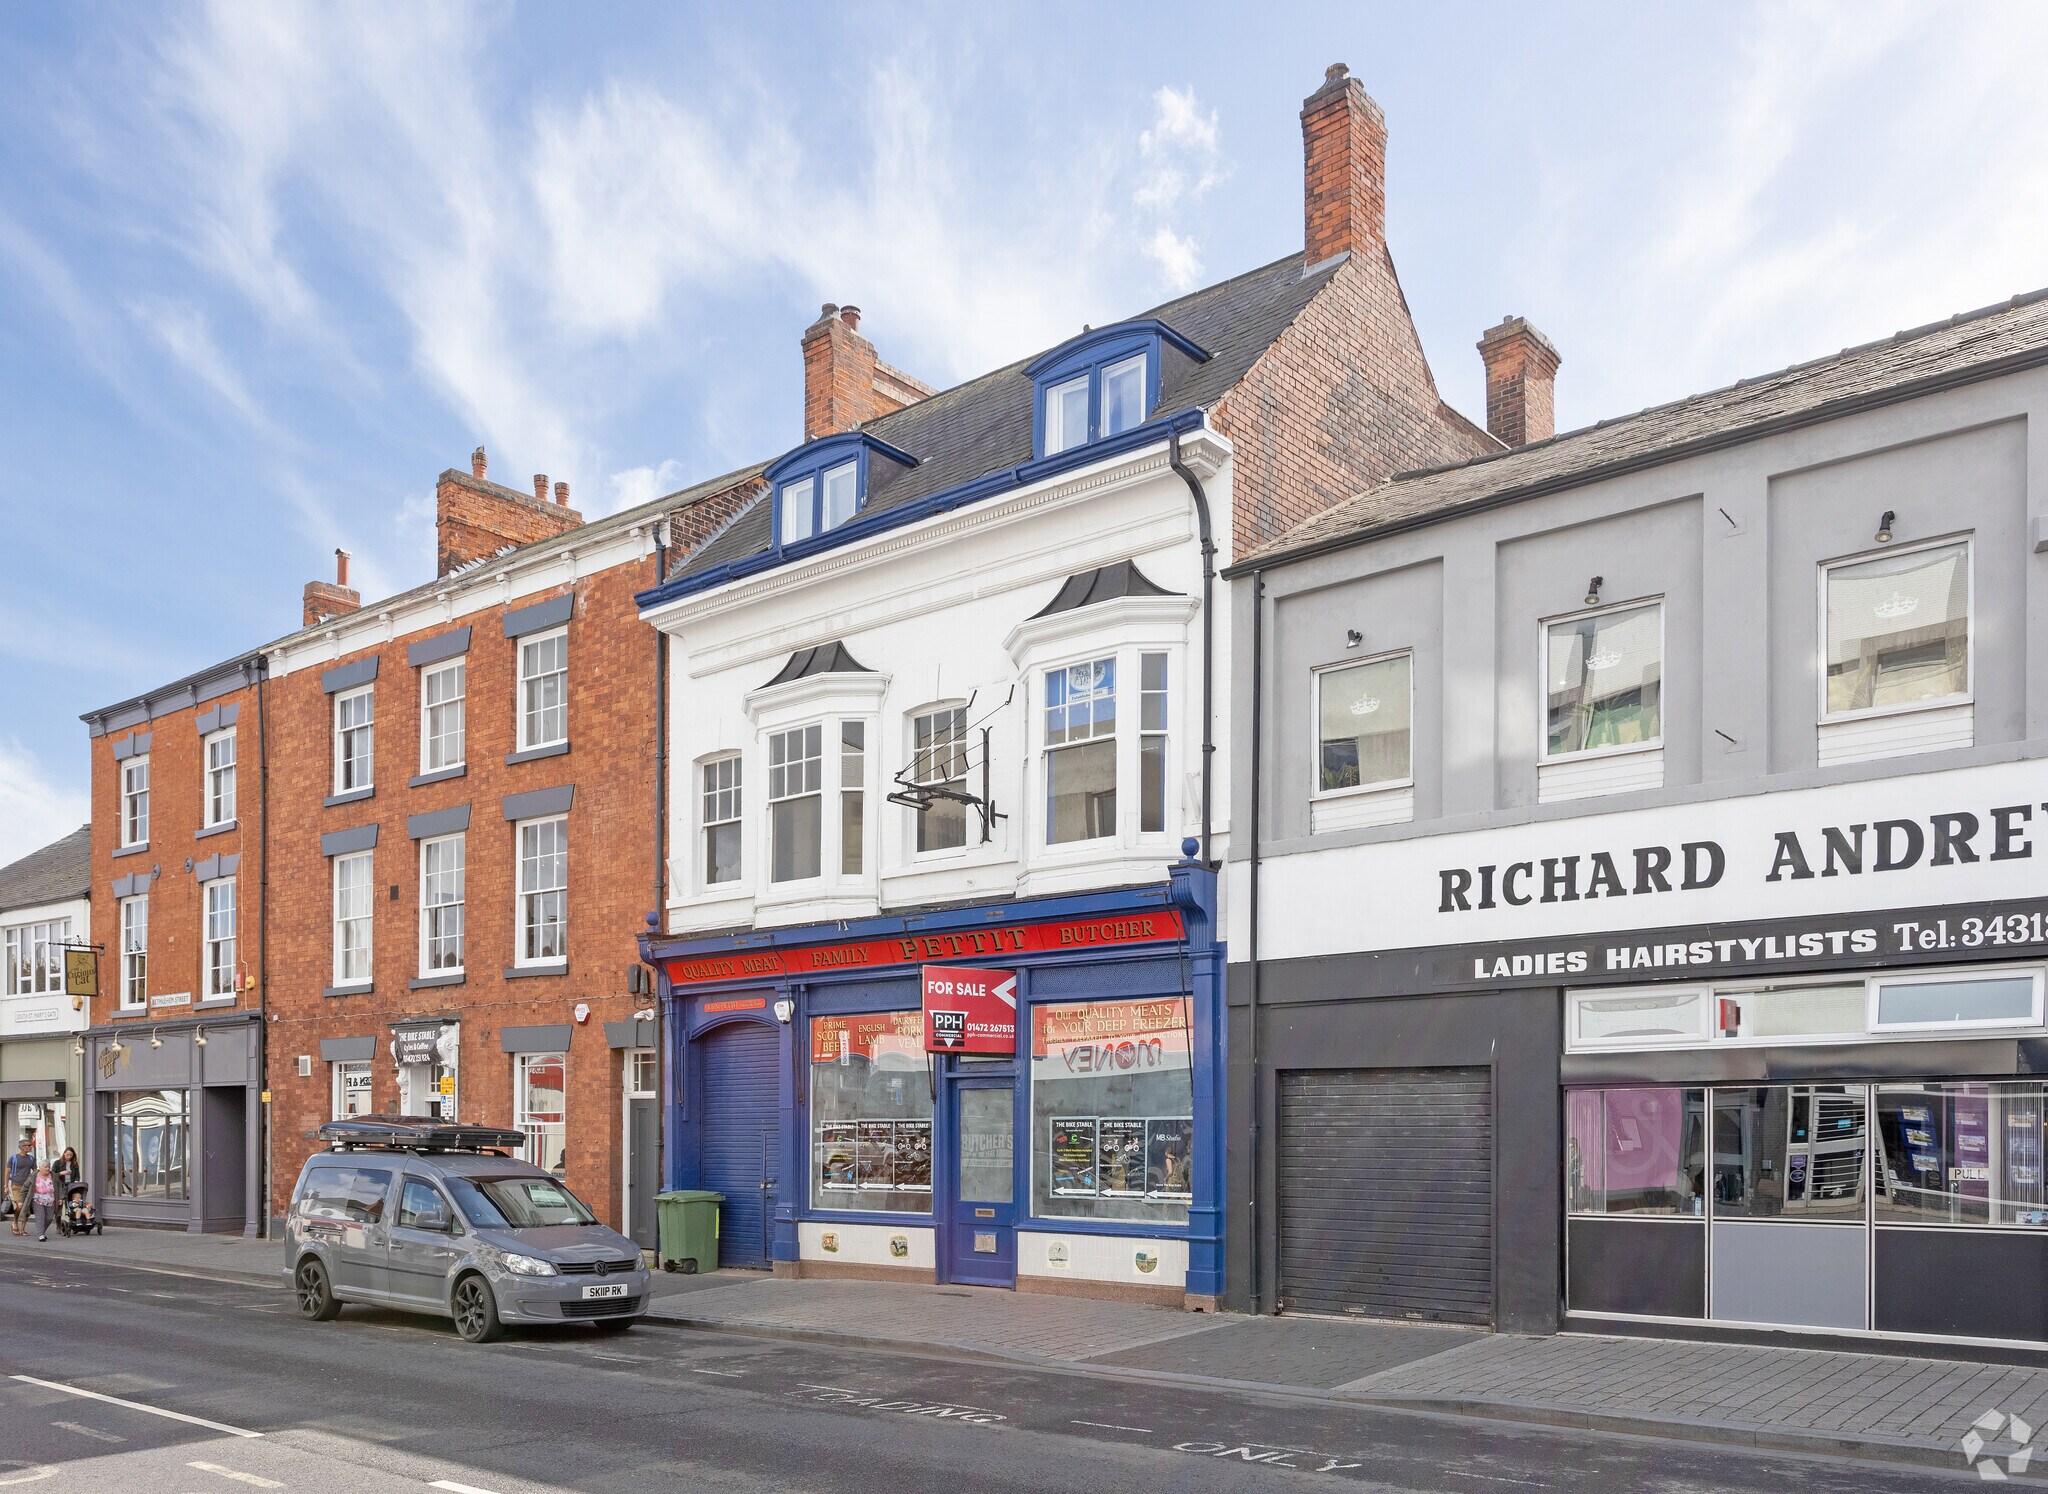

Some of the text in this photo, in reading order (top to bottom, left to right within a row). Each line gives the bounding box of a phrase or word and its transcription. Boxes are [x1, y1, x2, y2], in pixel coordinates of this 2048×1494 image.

[1438, 803, 2048, 913] RICHARD ANDRE
[1059, 919, 1155, 944] BUTCHER
[899, 929, 1025, 960] PETTIT
[1474, 912, 2048, 979] LADIES HAIRSTYLISTS Tel: 3431
[811, 947, 869, 968] FAMILY
[67, 969, 96, 979] Curious
[682, 956, 778, 980] QUALITY MEAT
[75, 976, 90, 985] Cat
[928, 981, 986, 997] FOR SALE
[175, 995, 189, 1003] STREET
[1055, 1004, 1172, 1021] Our QUALITY MEATS
[823, 1020, 846, 1030] PRIME
[935, 1014, 963, 1029] PPH
[966, 1022, 1015, 1033] 01472 267513
[1043, 1016, 1186, 1034] for YOUR DEEP FREEZER
[858, 1024, 886, 1033] ENGLISH
[897, 1026, 923, 1037] PORK
[398, 1030, 436, 1042] THE BIKE STABLE
[858, 1035, 885, 1045] LAMB
[1071, 1034, 1103, 1043] PREPARED
[1120, 1033, 1136, 1041] YOUR
[1139, 1030, 1187, 1039] INSTRUCTIONS
[822, 1041, 842, 1052] BEE
[897, 1039, 923, 1048] VEAL
[961, 1134, 1013, 1152] BUTCHER'S
[1166, 1133, 1181, 1141] Studio
[1954, 1168, 1985, 1179] PULL
[611, 1286, 622, 1296] RK
[1172, 1441, 1363, 1472] ONLY
